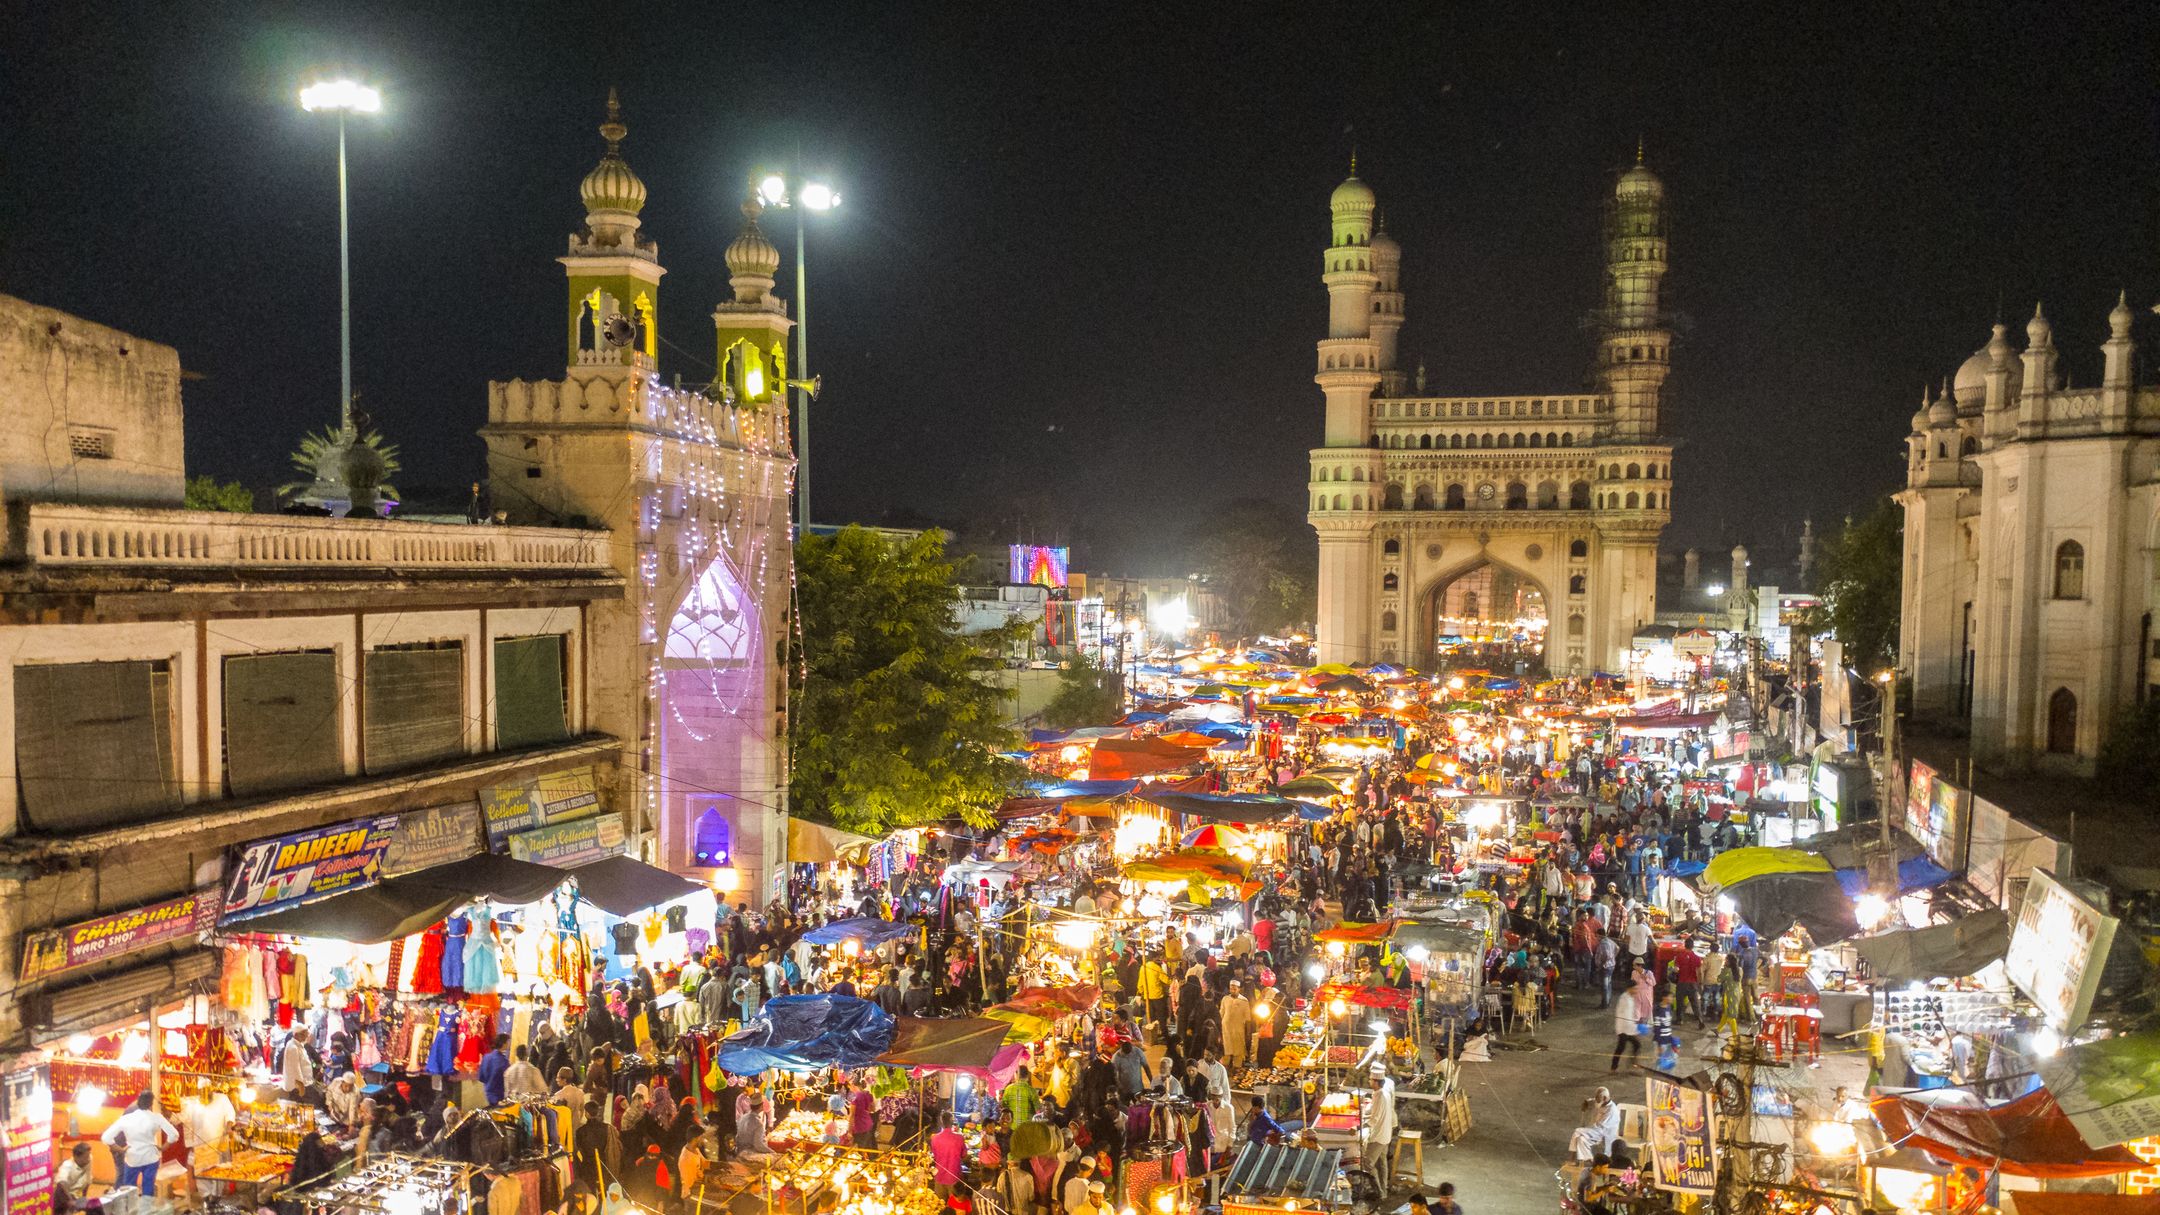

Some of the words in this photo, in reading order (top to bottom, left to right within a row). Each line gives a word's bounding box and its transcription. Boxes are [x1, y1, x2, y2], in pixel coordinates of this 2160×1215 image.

[487, 800, 529, 821] Collection
[546, 800, 567, 815] CATERING
[520, 815, 533, 826] WEAR
[275, 828, 369, 871] RAHEEM
[412, 835, 459, 853] COLLECTION
[529, 834, 557, 854] Najeeb
[558, 827, 598, 846] Collection
[579, 839, 594, 852] WEAR
[314, 854, 371, 878] Collection
[74, 900, 196, 944] CHARMINAR
[108, 931, 138, 950] SHOP
